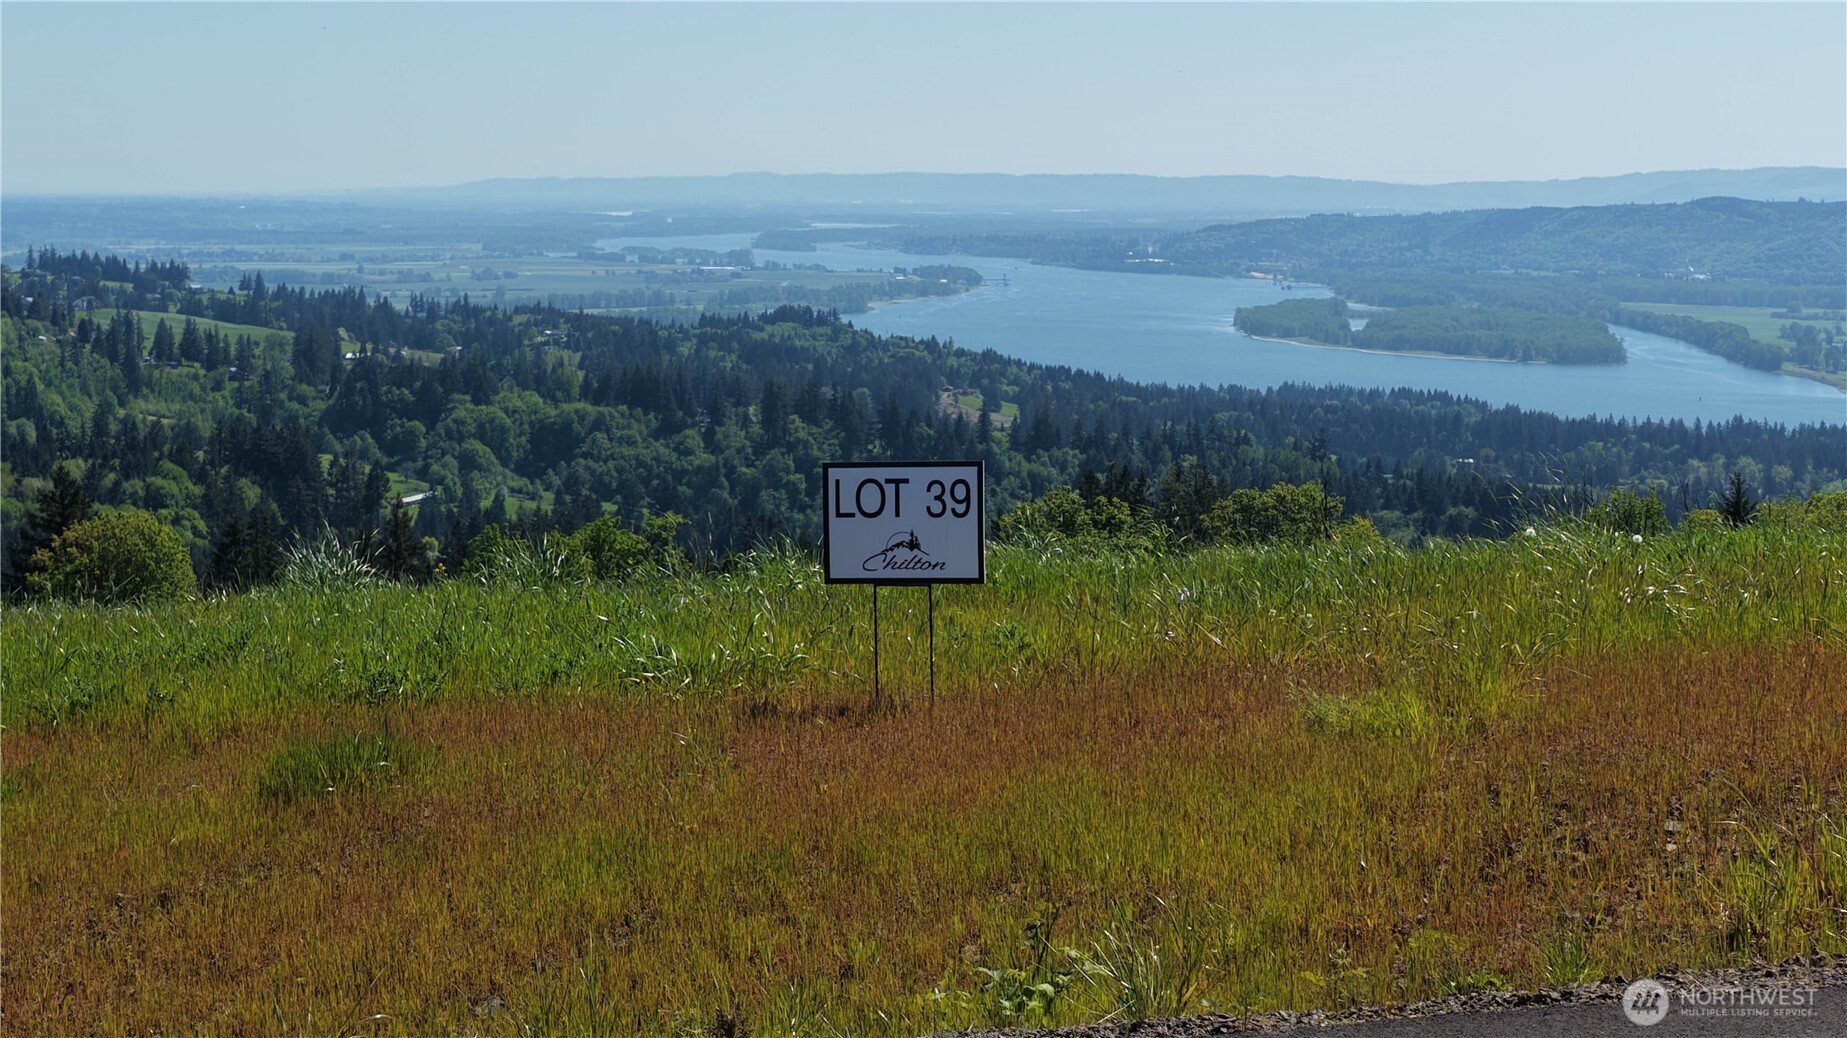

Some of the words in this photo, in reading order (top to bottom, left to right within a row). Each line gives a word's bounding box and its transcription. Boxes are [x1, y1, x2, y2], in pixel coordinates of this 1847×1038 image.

[835, 478, 909, 518] LOT
[926, 479, 971, 518] 39
[862, 552, 946, 571] Chilton
